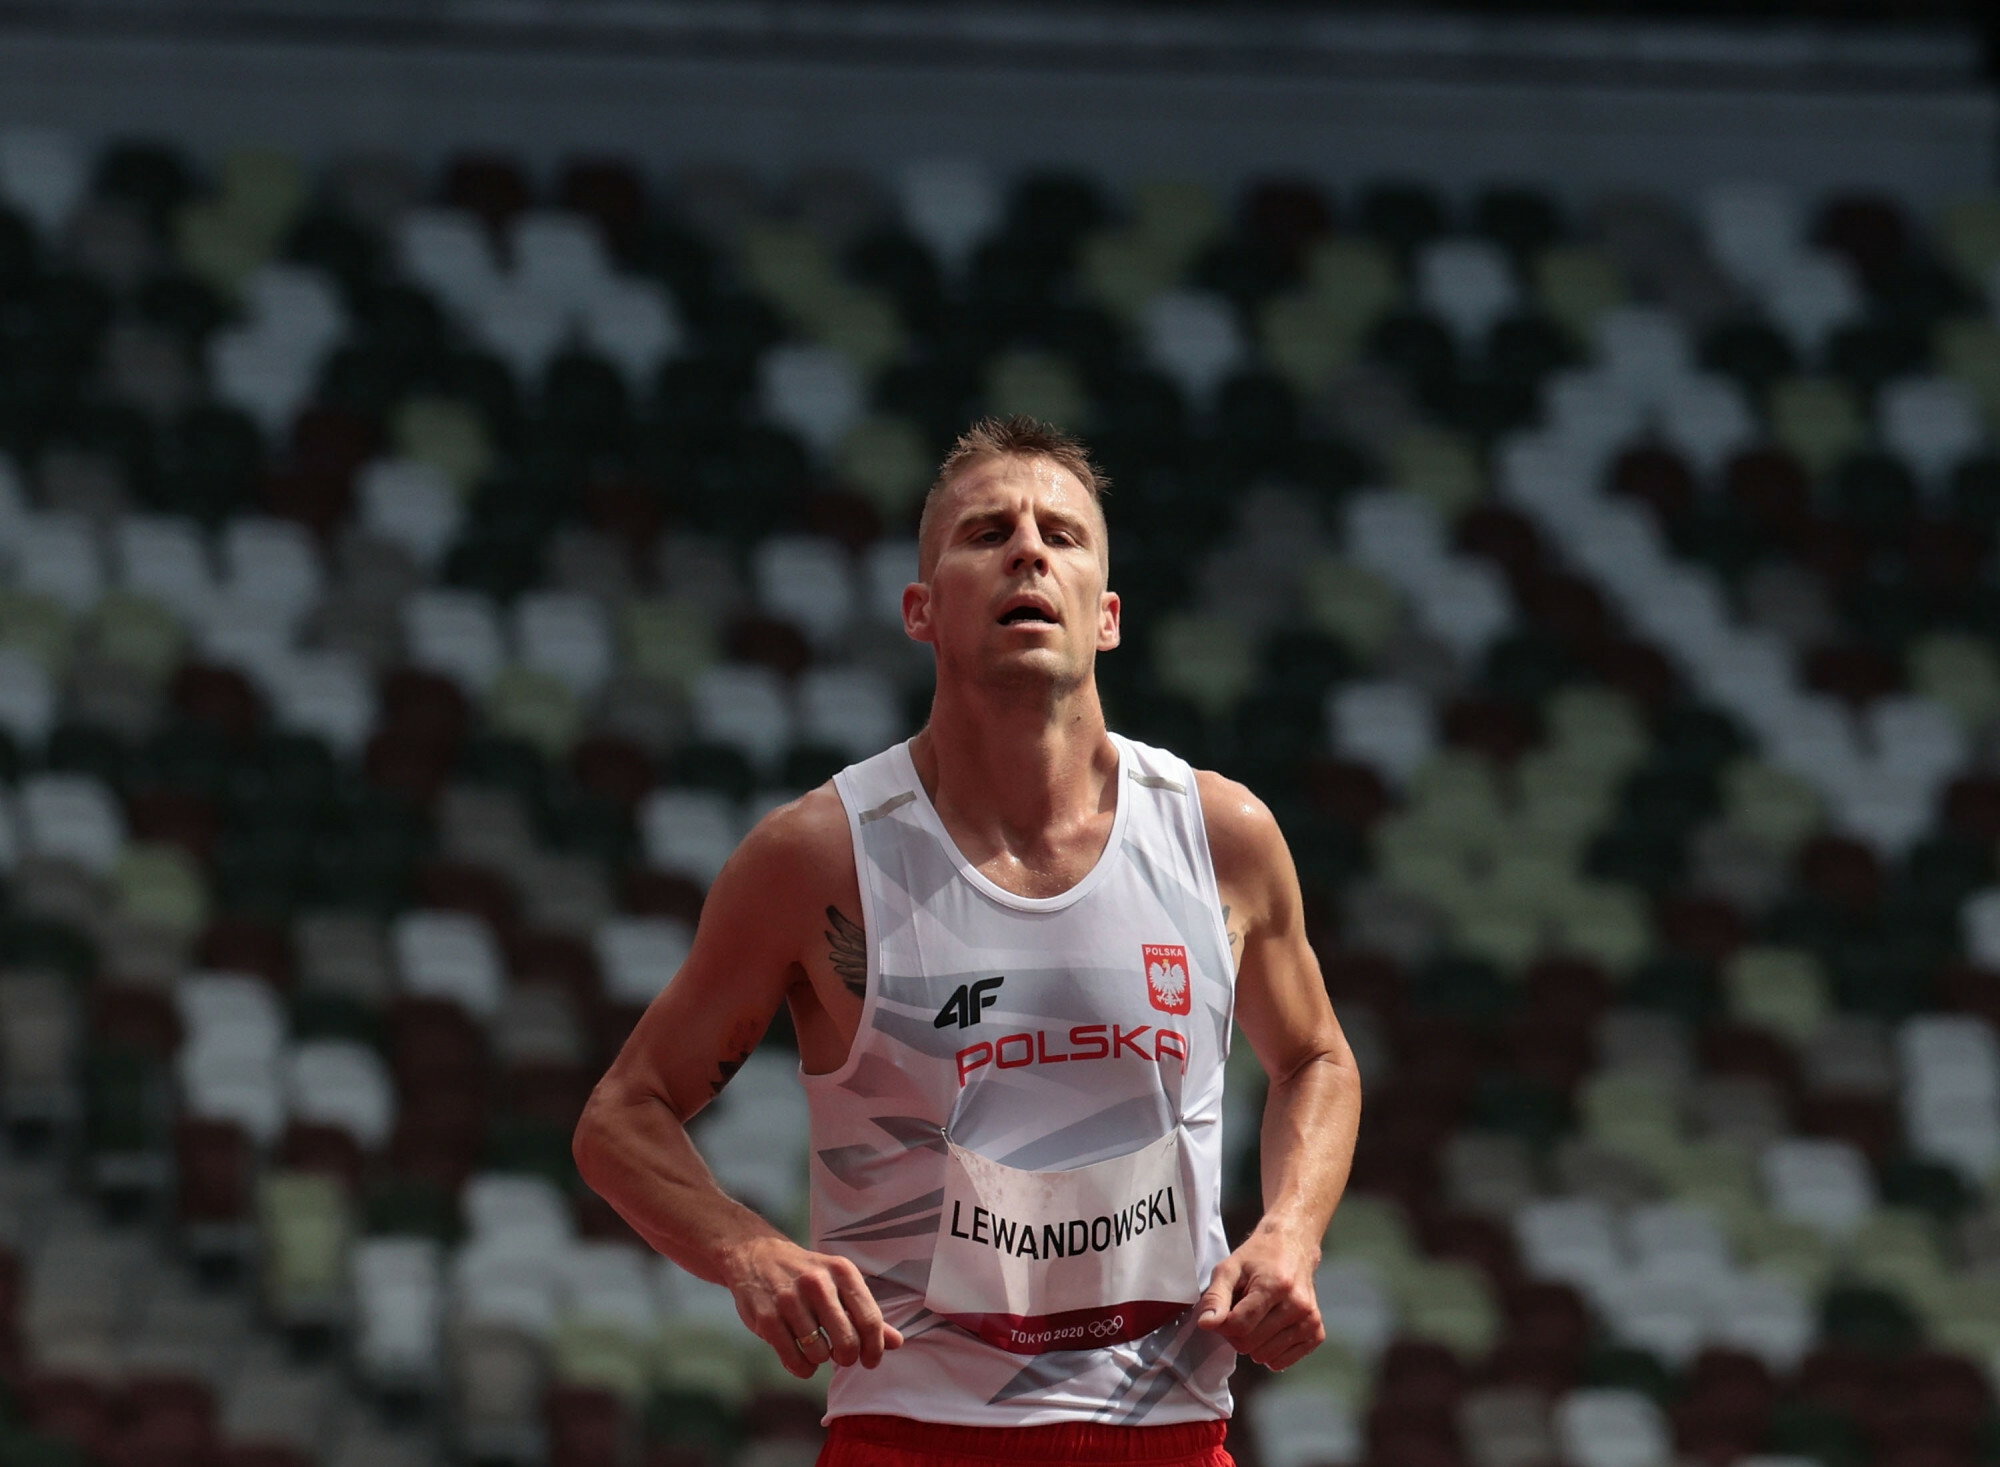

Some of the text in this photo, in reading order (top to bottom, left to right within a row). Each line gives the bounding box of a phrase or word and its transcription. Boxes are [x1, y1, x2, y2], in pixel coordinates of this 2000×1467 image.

[1145, 946, 1183, 957] POLSKA
[933, 976, 1005, 1029] 4F
[955, 1024, 1188, 1088] POLSKA
[950, 1186, 1177, 1260] LEWANDOWSKI
[1010, 1327, 1084, 1344] TOKYO 2020
